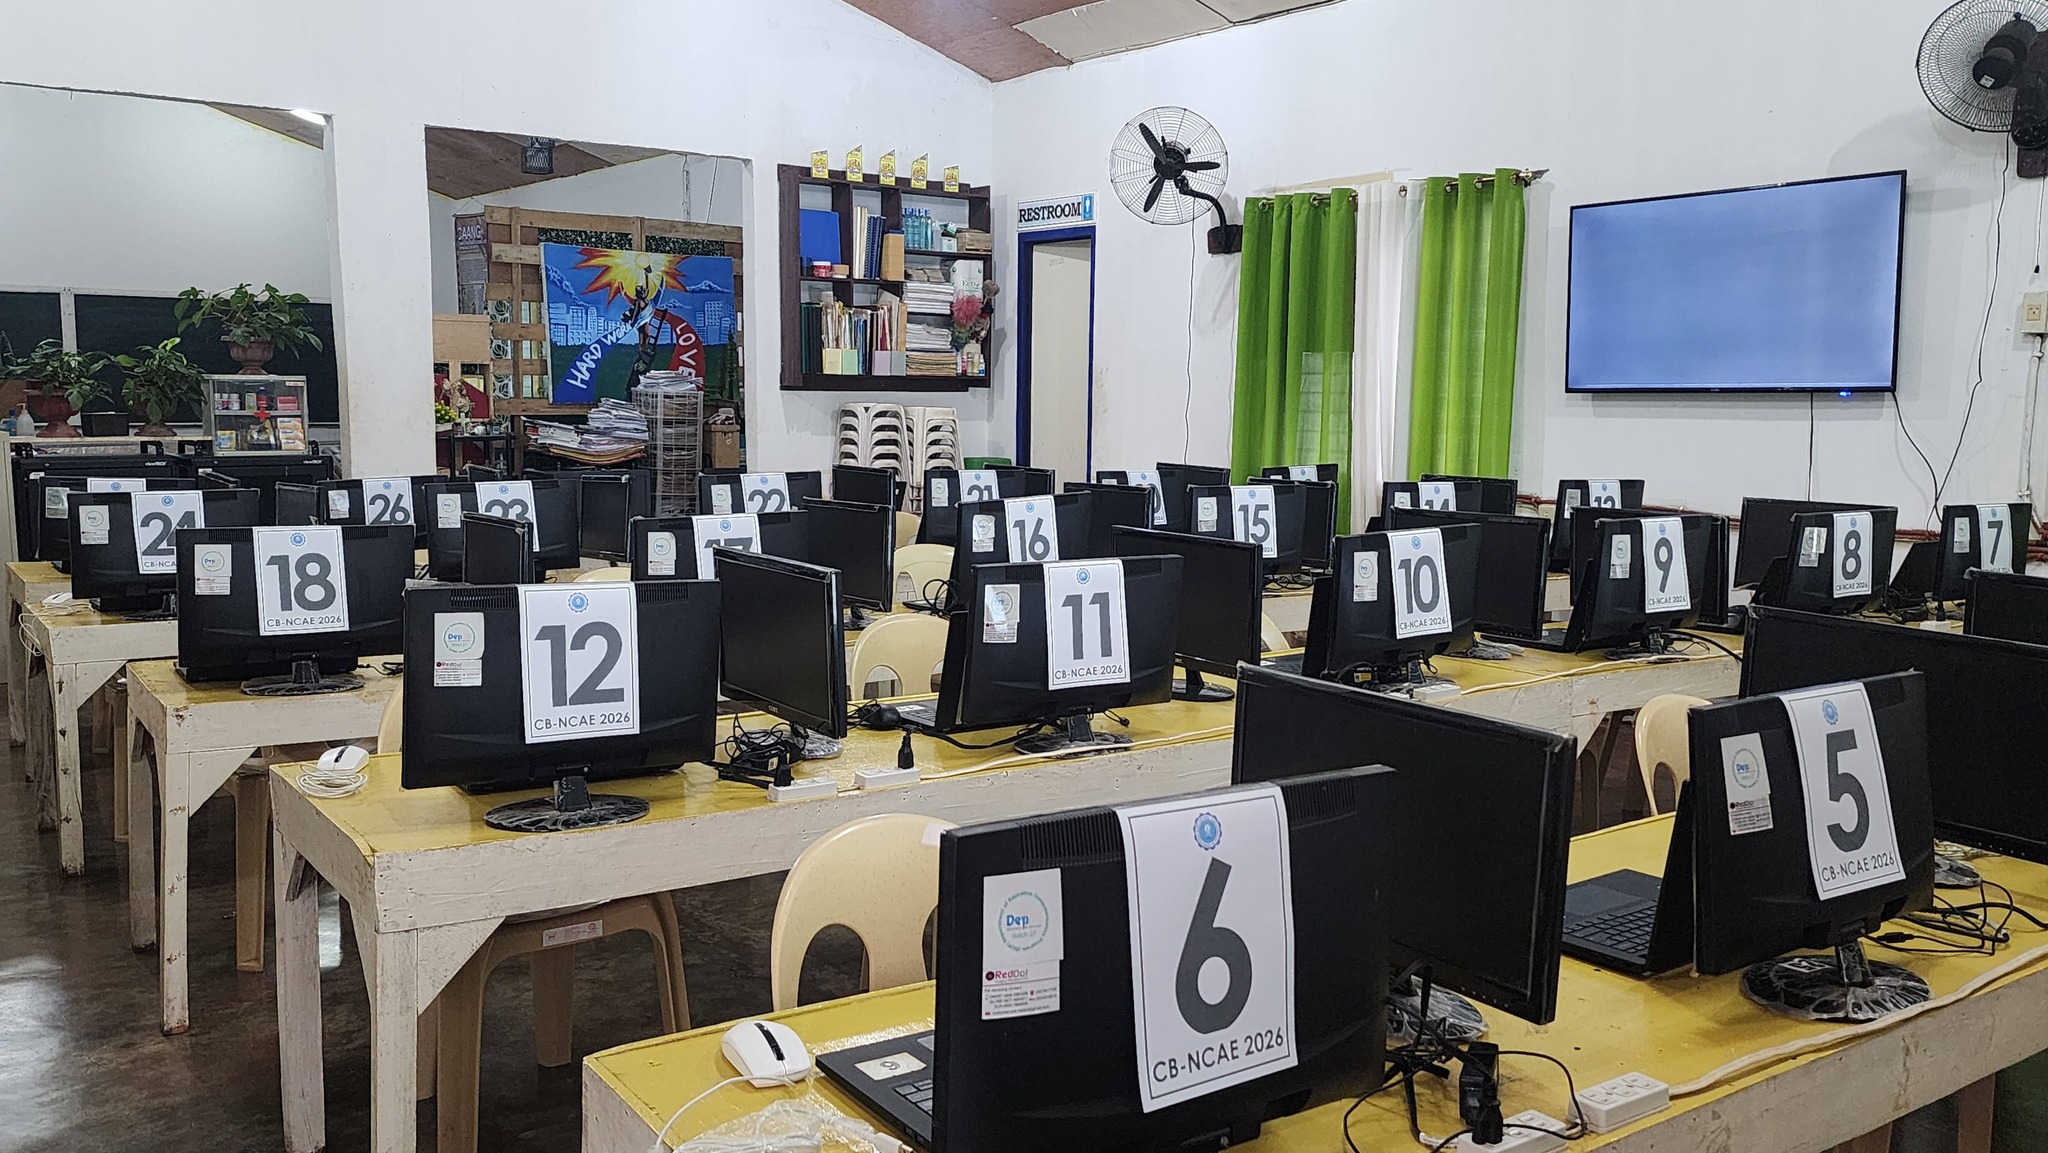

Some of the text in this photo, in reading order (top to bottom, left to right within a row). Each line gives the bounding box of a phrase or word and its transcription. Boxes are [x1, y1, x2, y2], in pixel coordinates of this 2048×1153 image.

[1019, 202, 1082, 223] RESTROOM
[566, 321, 633, 389] HARD WORK
[675, 322, 699, 381] LOVE
[369, 493, 411, 525] 26
[1237, 504, 1271, 544] 15
[140, 510, 196, 556] 24
[1012, 517, 1051, 561] 16
[1841, 529, 1862, 581] 8
[1987, 519, 2004, 565] 7
[144, 560, 177, 568] CB-NCA
[265, 552, 337, 612] 18
[1397, 555, 1441, 614] 10
[1653, 536, 1674, 594] 9
[266, 614, 342, 628] CB-NCAE 2026
[1061, 591, 1113, 660] 11
[1399, 616, 1447, 631] CB-NCAE 2026
[534, 621, 625, 707] 12
[1054, 664, 1123, 680] CB-NCAE 2026
[534, 711, 631, 731] CB-NCAE 2026
[1826, 729, 1870, 852] 5
[1821, 852, 1896, 883] CB-NCAE 2026
[1175, 856, 1253, 1035] 6
[1152, 1027, 1284, 1083] CB-NCAE 2026
